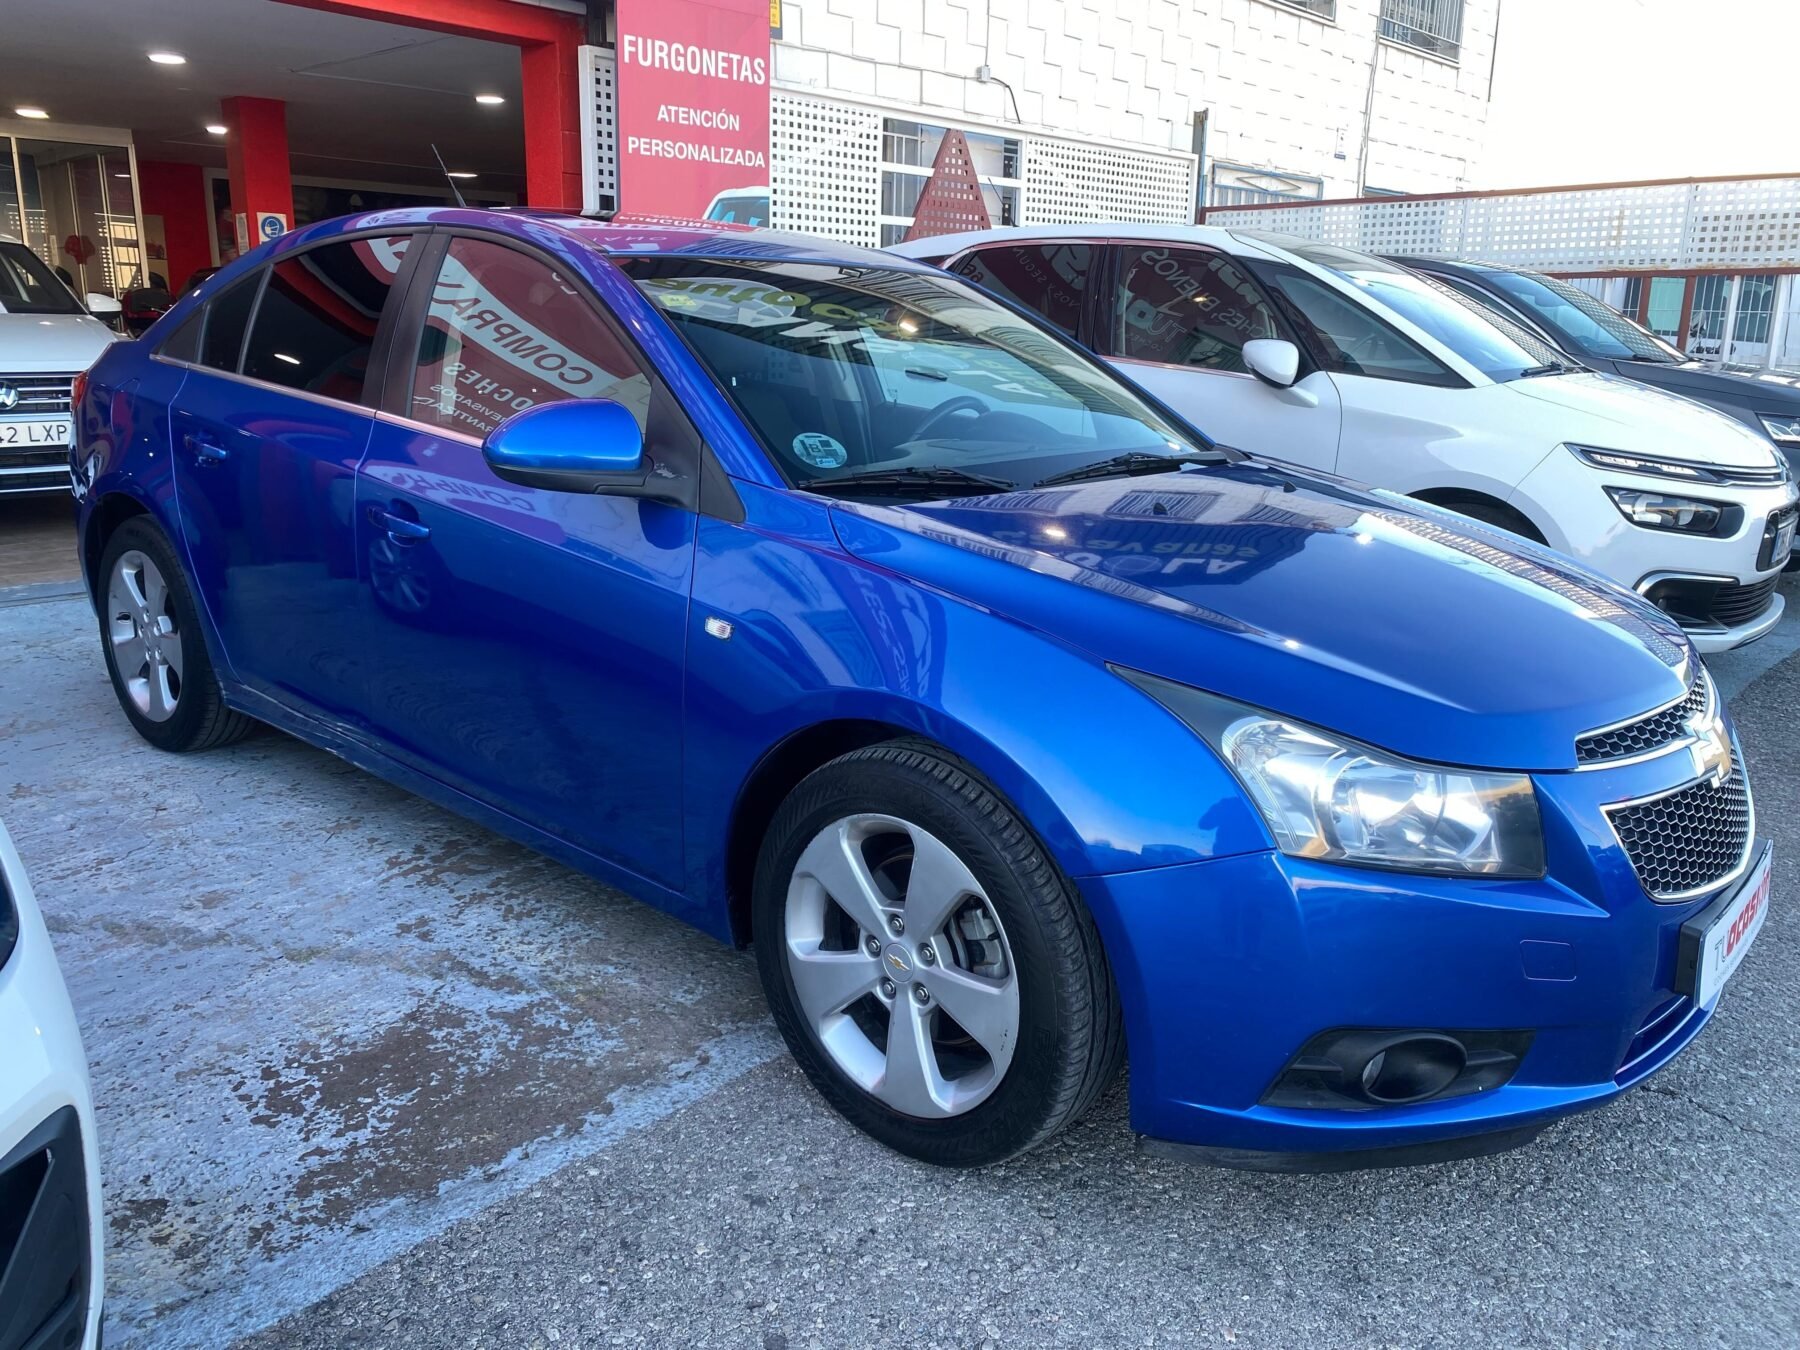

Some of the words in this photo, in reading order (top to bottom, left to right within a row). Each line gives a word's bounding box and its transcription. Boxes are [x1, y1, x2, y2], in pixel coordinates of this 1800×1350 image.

[623, 34, 766, 85] FURGONETAS
[657, 104, 740, 131] ATENCIÓN
[628, 136, 766, 168] PERSONALIZADA
[28, 424, 68, 443] LXP
